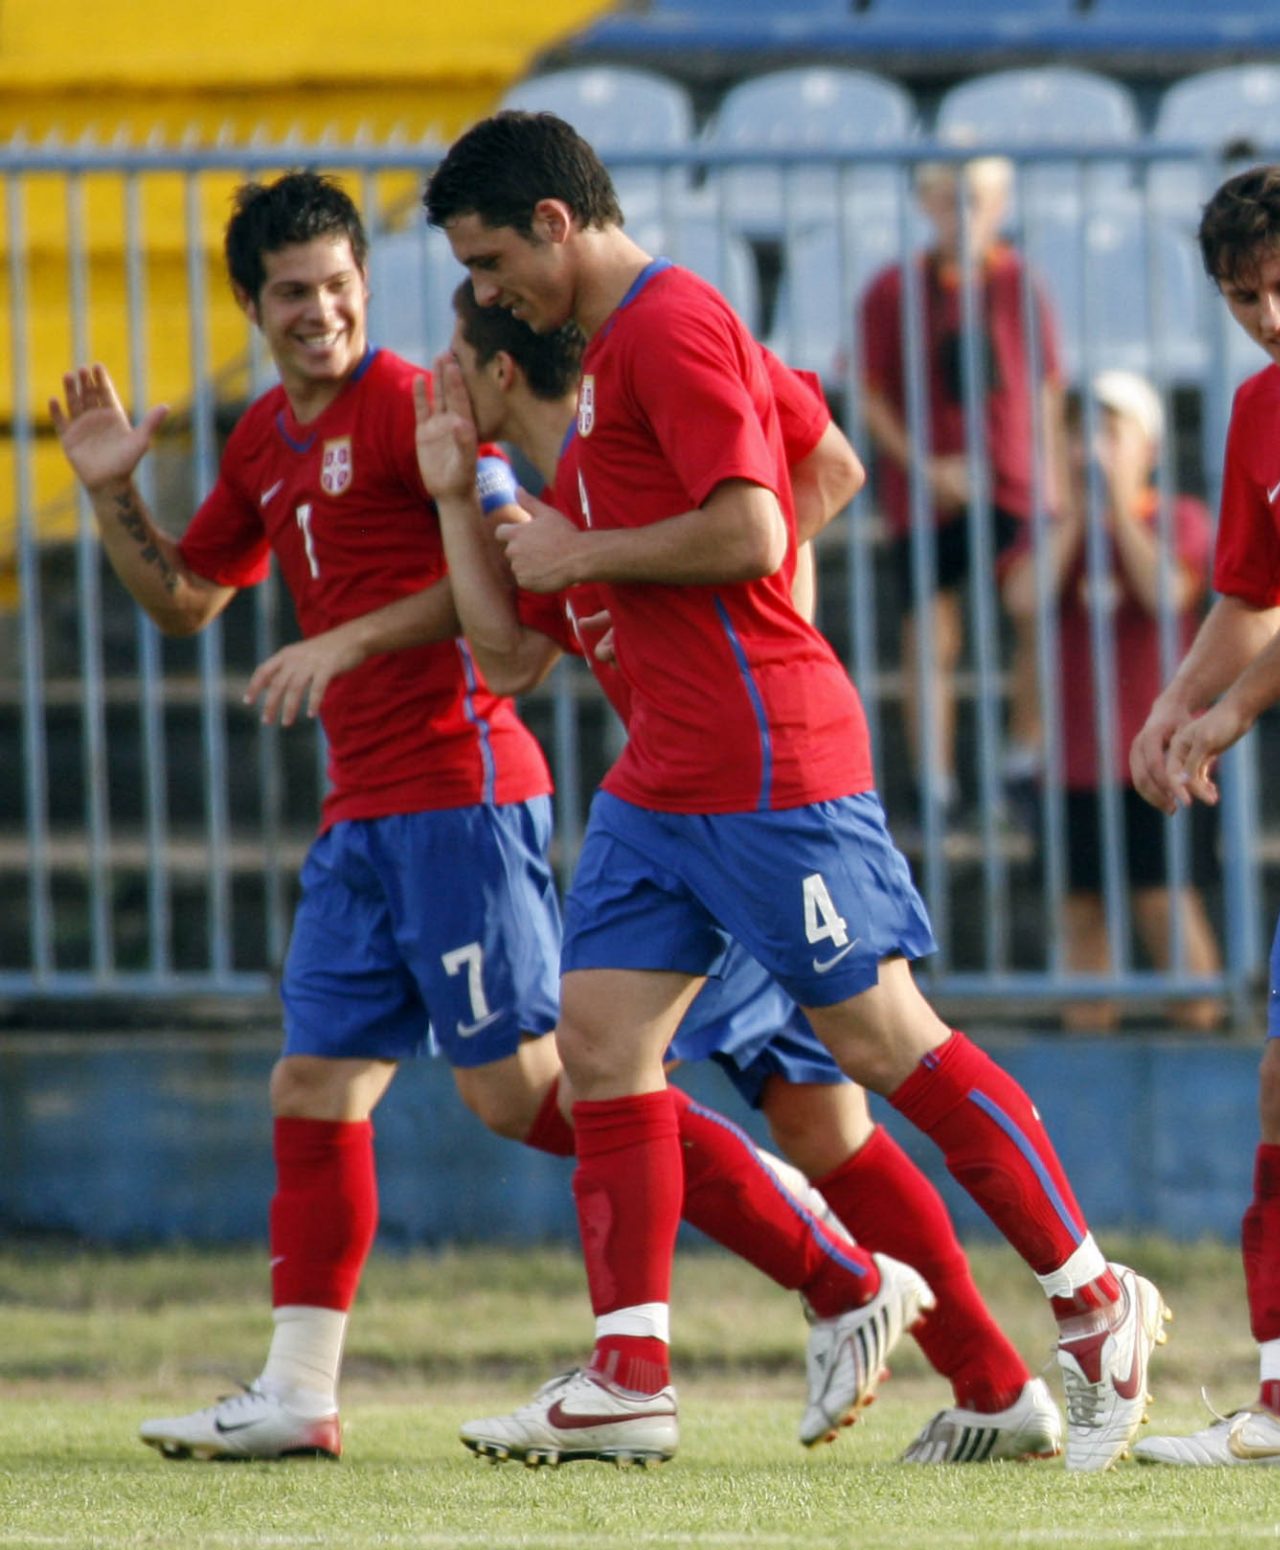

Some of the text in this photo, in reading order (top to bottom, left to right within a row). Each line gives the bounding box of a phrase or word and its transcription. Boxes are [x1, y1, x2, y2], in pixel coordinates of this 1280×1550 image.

[296, 503, 320, 580] 7
[802, 873, 849, 948] 4
[441, 942, 489, 1021] 7
